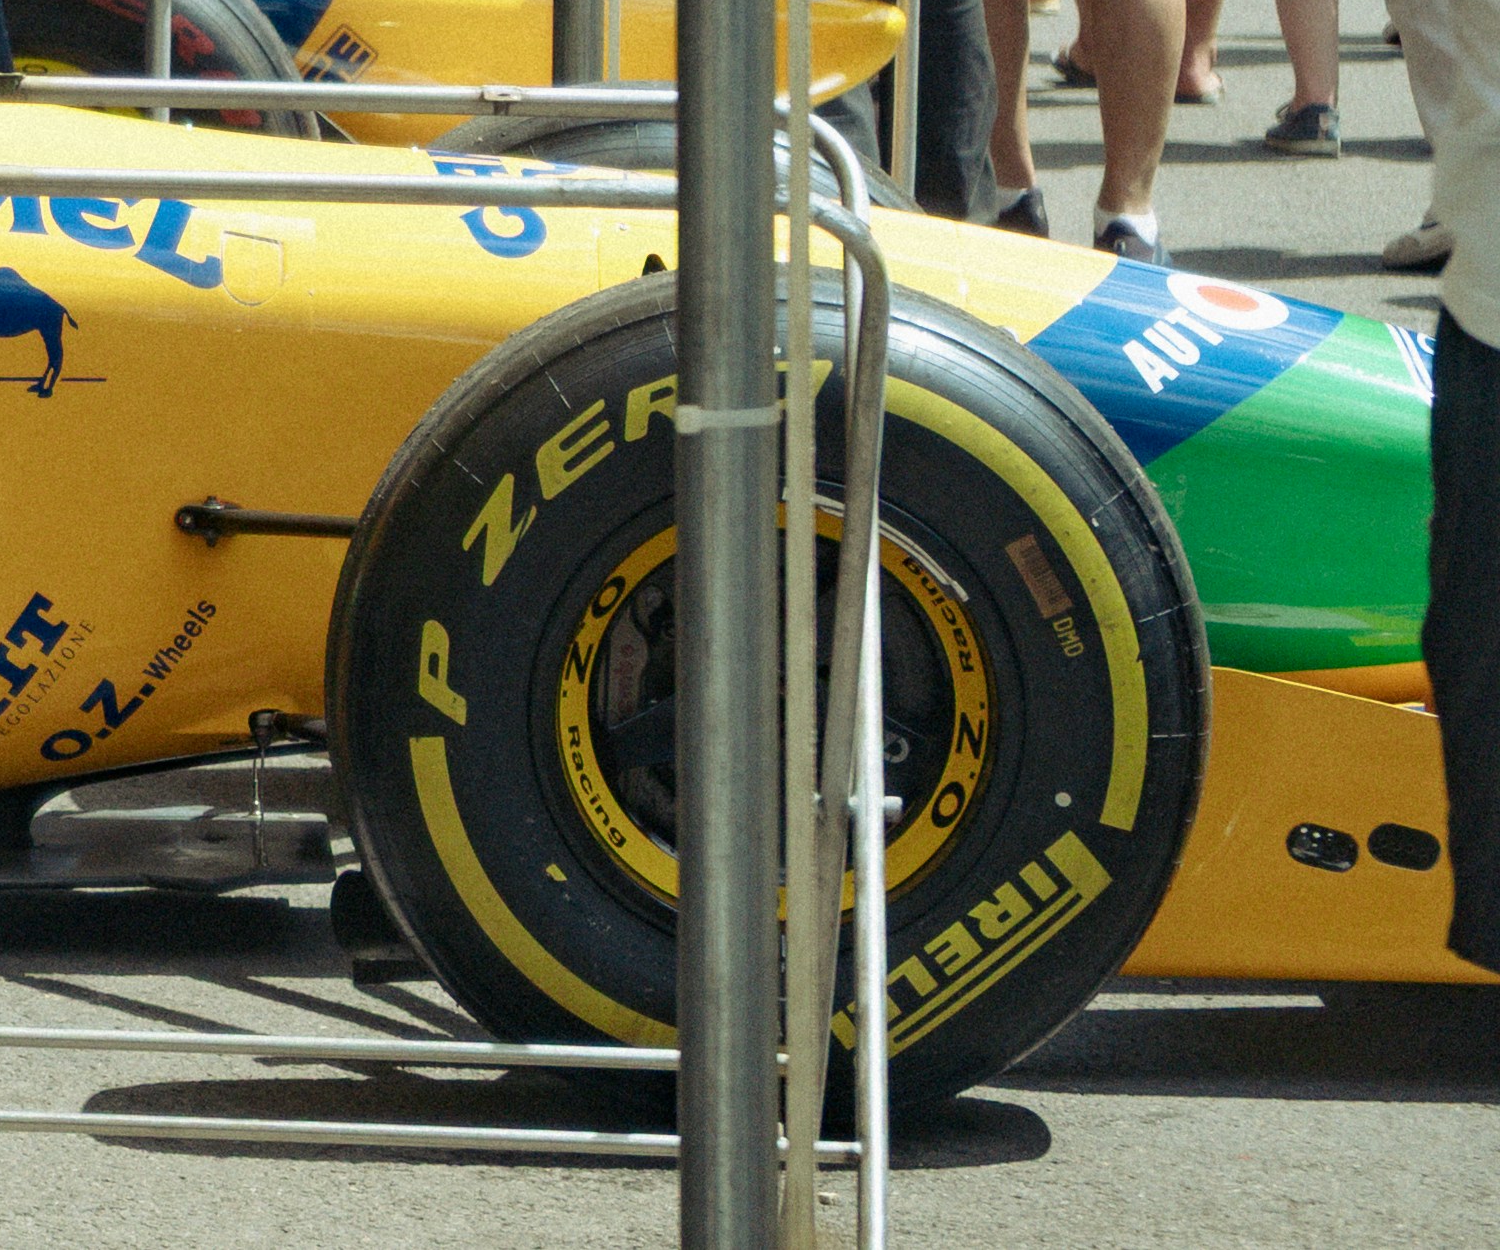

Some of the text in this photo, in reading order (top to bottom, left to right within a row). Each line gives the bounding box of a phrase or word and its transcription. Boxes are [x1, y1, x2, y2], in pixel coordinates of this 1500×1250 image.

[1122, 272, 1290, 395] AUTO
[142, 598, 218, 683] Wheels
[418, 618, 468, 727] P
[901, 554, 975, 674] Racing
[567, 724, 628, 850] Racing
